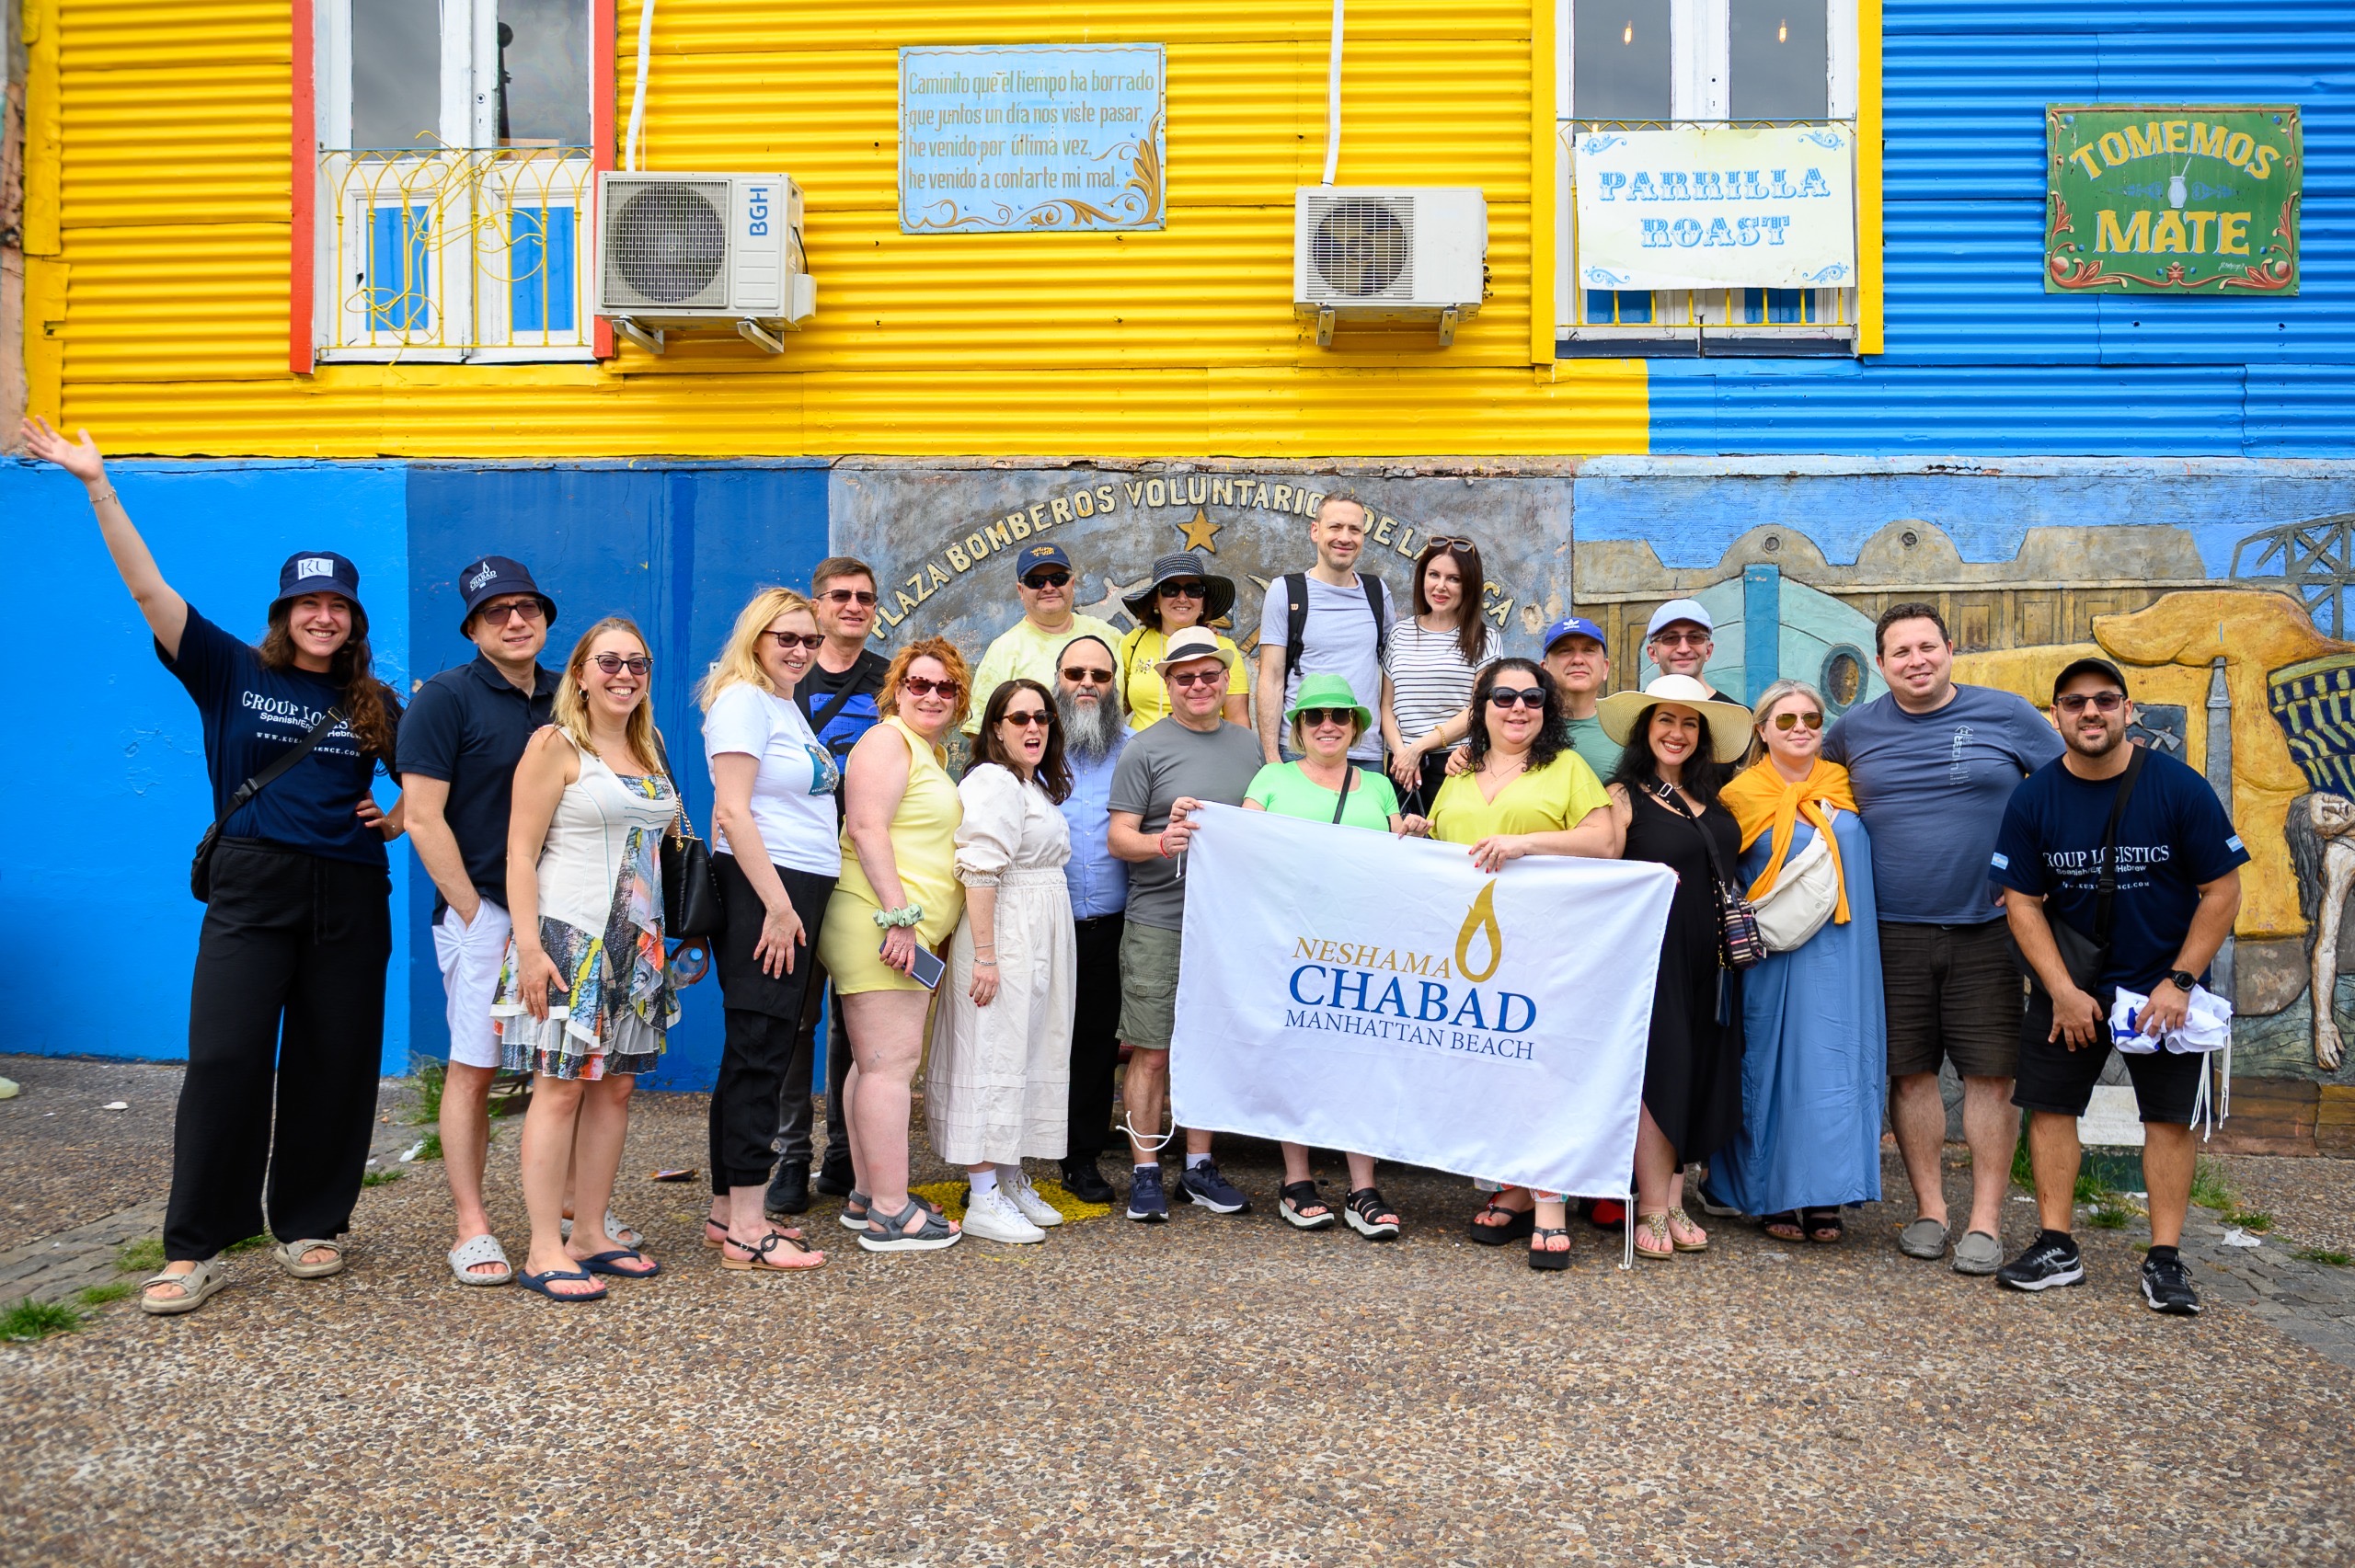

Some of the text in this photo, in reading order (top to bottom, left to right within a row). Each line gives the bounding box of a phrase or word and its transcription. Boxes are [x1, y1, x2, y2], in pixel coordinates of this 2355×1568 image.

[909, 69, 1155, 100] Caminito que el tiempo ha borrado
[909, 101, 1143, 132] que juntos un día nos viste pasar,
[908, 133, 1092, 162] he venido por última vez,
[2069, 120, 2281, 181] TOMEMOS
[908, 166, 1120, 189] he venido a contarte mi mal.
[1599, 167, 1831, 200] PARRILLA
[749, 188, 768, 236] BGH
[1640, 215, 1789, 247] ROAST
[2092, 209, 2251, 257] MATE
[301, 559, 331, 576] KU
[871, 563, 950, 639] PLAZA
[944, 486, 1116, 574] BOMBEROS
[1125, 476, 1325, 520] VOLUNTARIO
[1482, 579, 1515, 628] CA
[242, 691, 299, 715] GROUP
[1292, 936, 1452, 979] NESHAMA
[1289, 965, 1537, 1033] CHABAD
[1284, 1009, 1535, 1060] MANHATTAN BEACH
